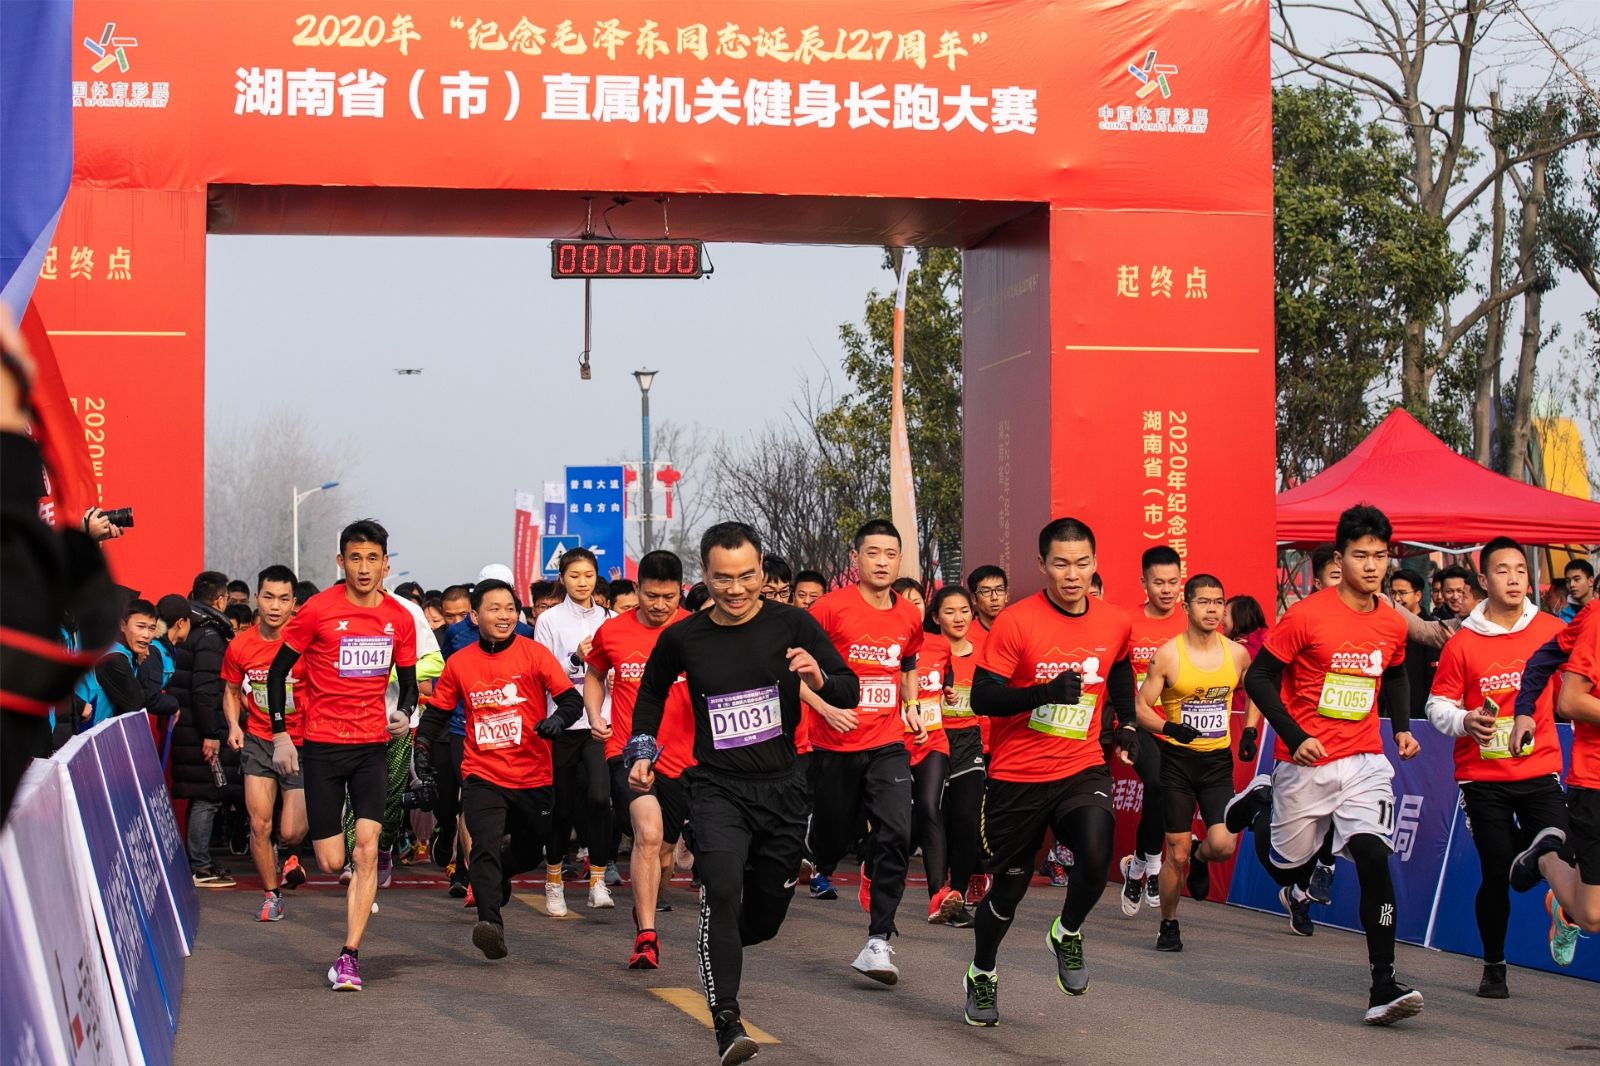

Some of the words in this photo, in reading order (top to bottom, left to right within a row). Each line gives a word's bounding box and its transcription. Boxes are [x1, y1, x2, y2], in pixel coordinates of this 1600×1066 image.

[234, 66, 1039, 135] 湖南省（市）直属机关健身长跑大赛
[1098, 104, 1209, 126] 中国体育彩票
[1099, 121, 1129, 131] CHINA
[1130, 122, 1166, 132] SPORTS
[1167, 123, 1207, 134] LOTTERY
[1116, 264, 1209, 299] 起终点
[341, 650, 386, 666] D1041
[1323, 687, 1368, 708] C1055
[713, 704, 772, 735] D1031
[1035, 704, 1087, 727] C1073
[1182, 714, 1223, 729] D1073
[478, 721, 518, 741] A1205
[1378, 800, 1393, 829] 11
